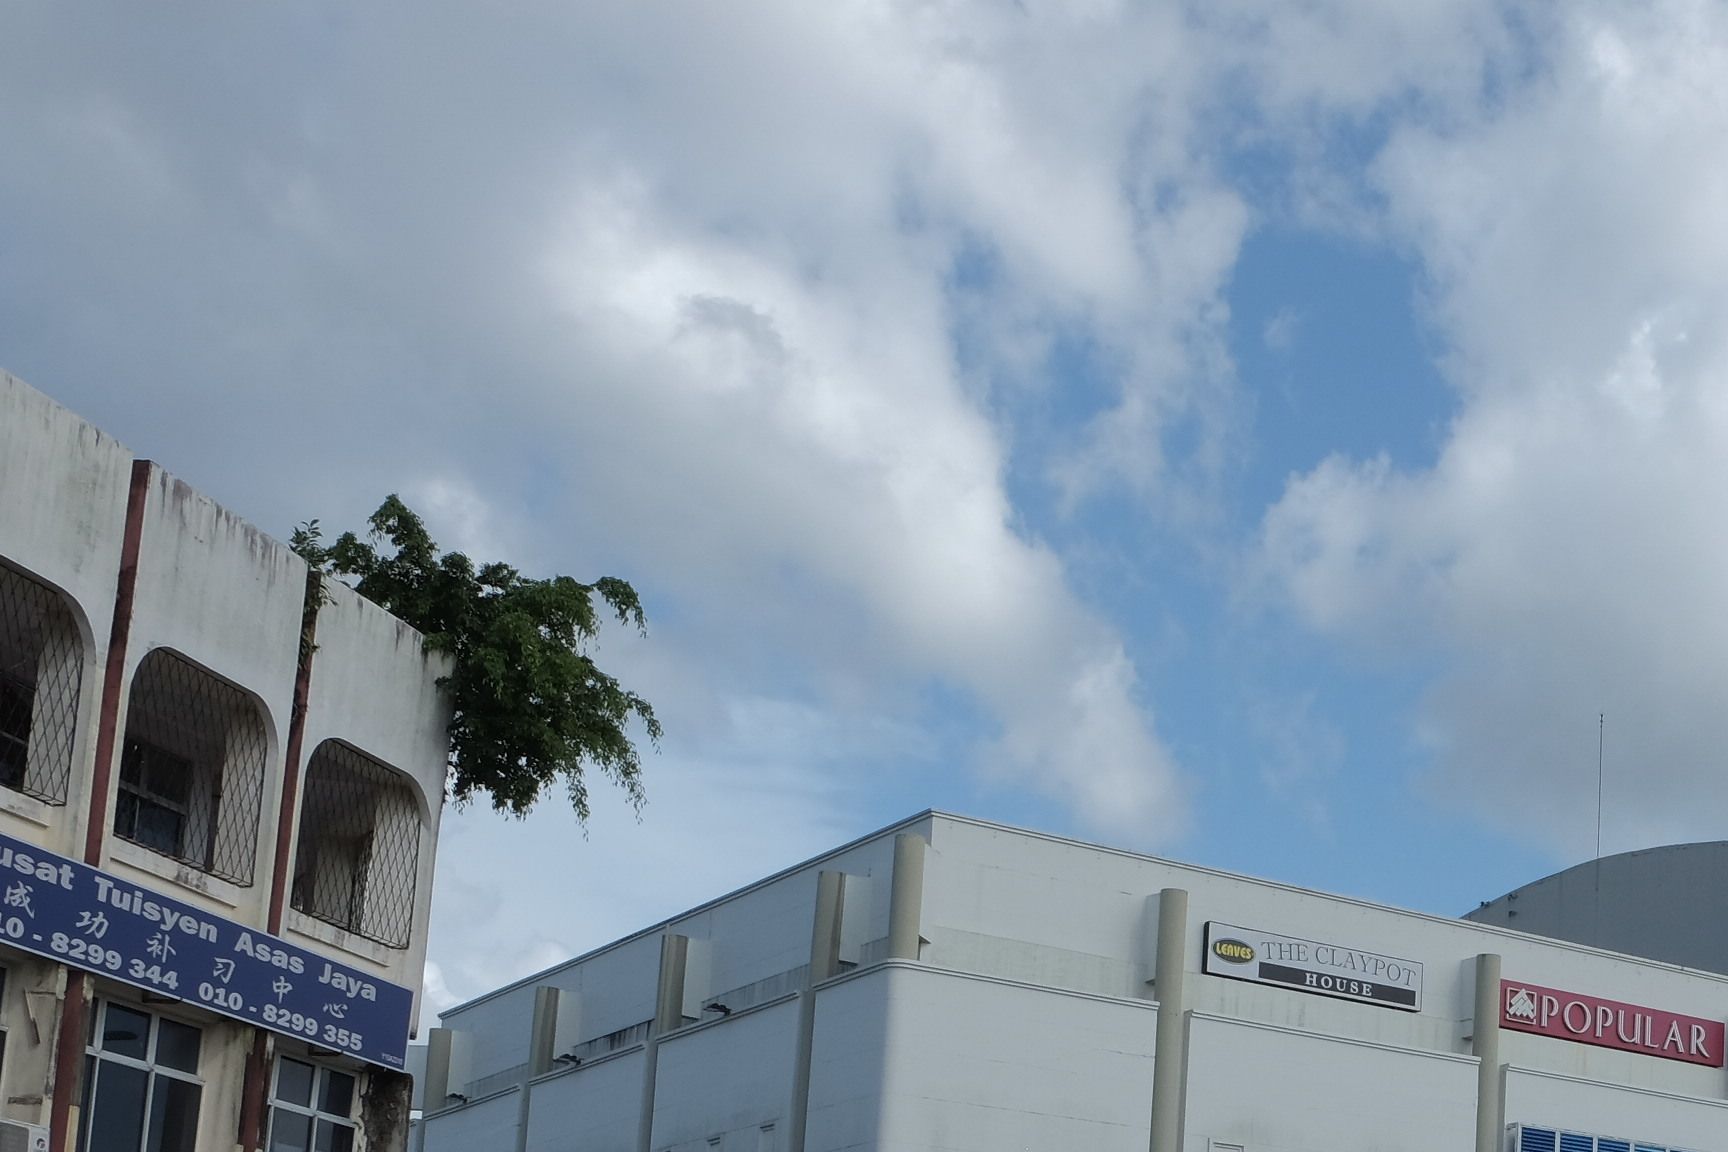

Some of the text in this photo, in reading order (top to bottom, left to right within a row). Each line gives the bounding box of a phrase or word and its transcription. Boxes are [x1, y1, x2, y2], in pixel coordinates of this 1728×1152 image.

[94, 876, 218, 943] Tuisyen
[234, 932, 305, 974] Asas
[318, 963, 377, 1001] Jaya
[1215, 942, 1252, 959] LEAVES
[1260, 941, 1416, 987] THE CLAYPOT
[50, 932, 122, 971] 8299
[128, 959, 179, 990] 344
[198, 982, 243, 1011] 010
[263, 1004, 318, 1036] 8299
[323, 1025, 363, 1051] 355
[1305, 972, 1373, 996] HOUSE
[1540, 995, 1711, 1060] POPULAR
